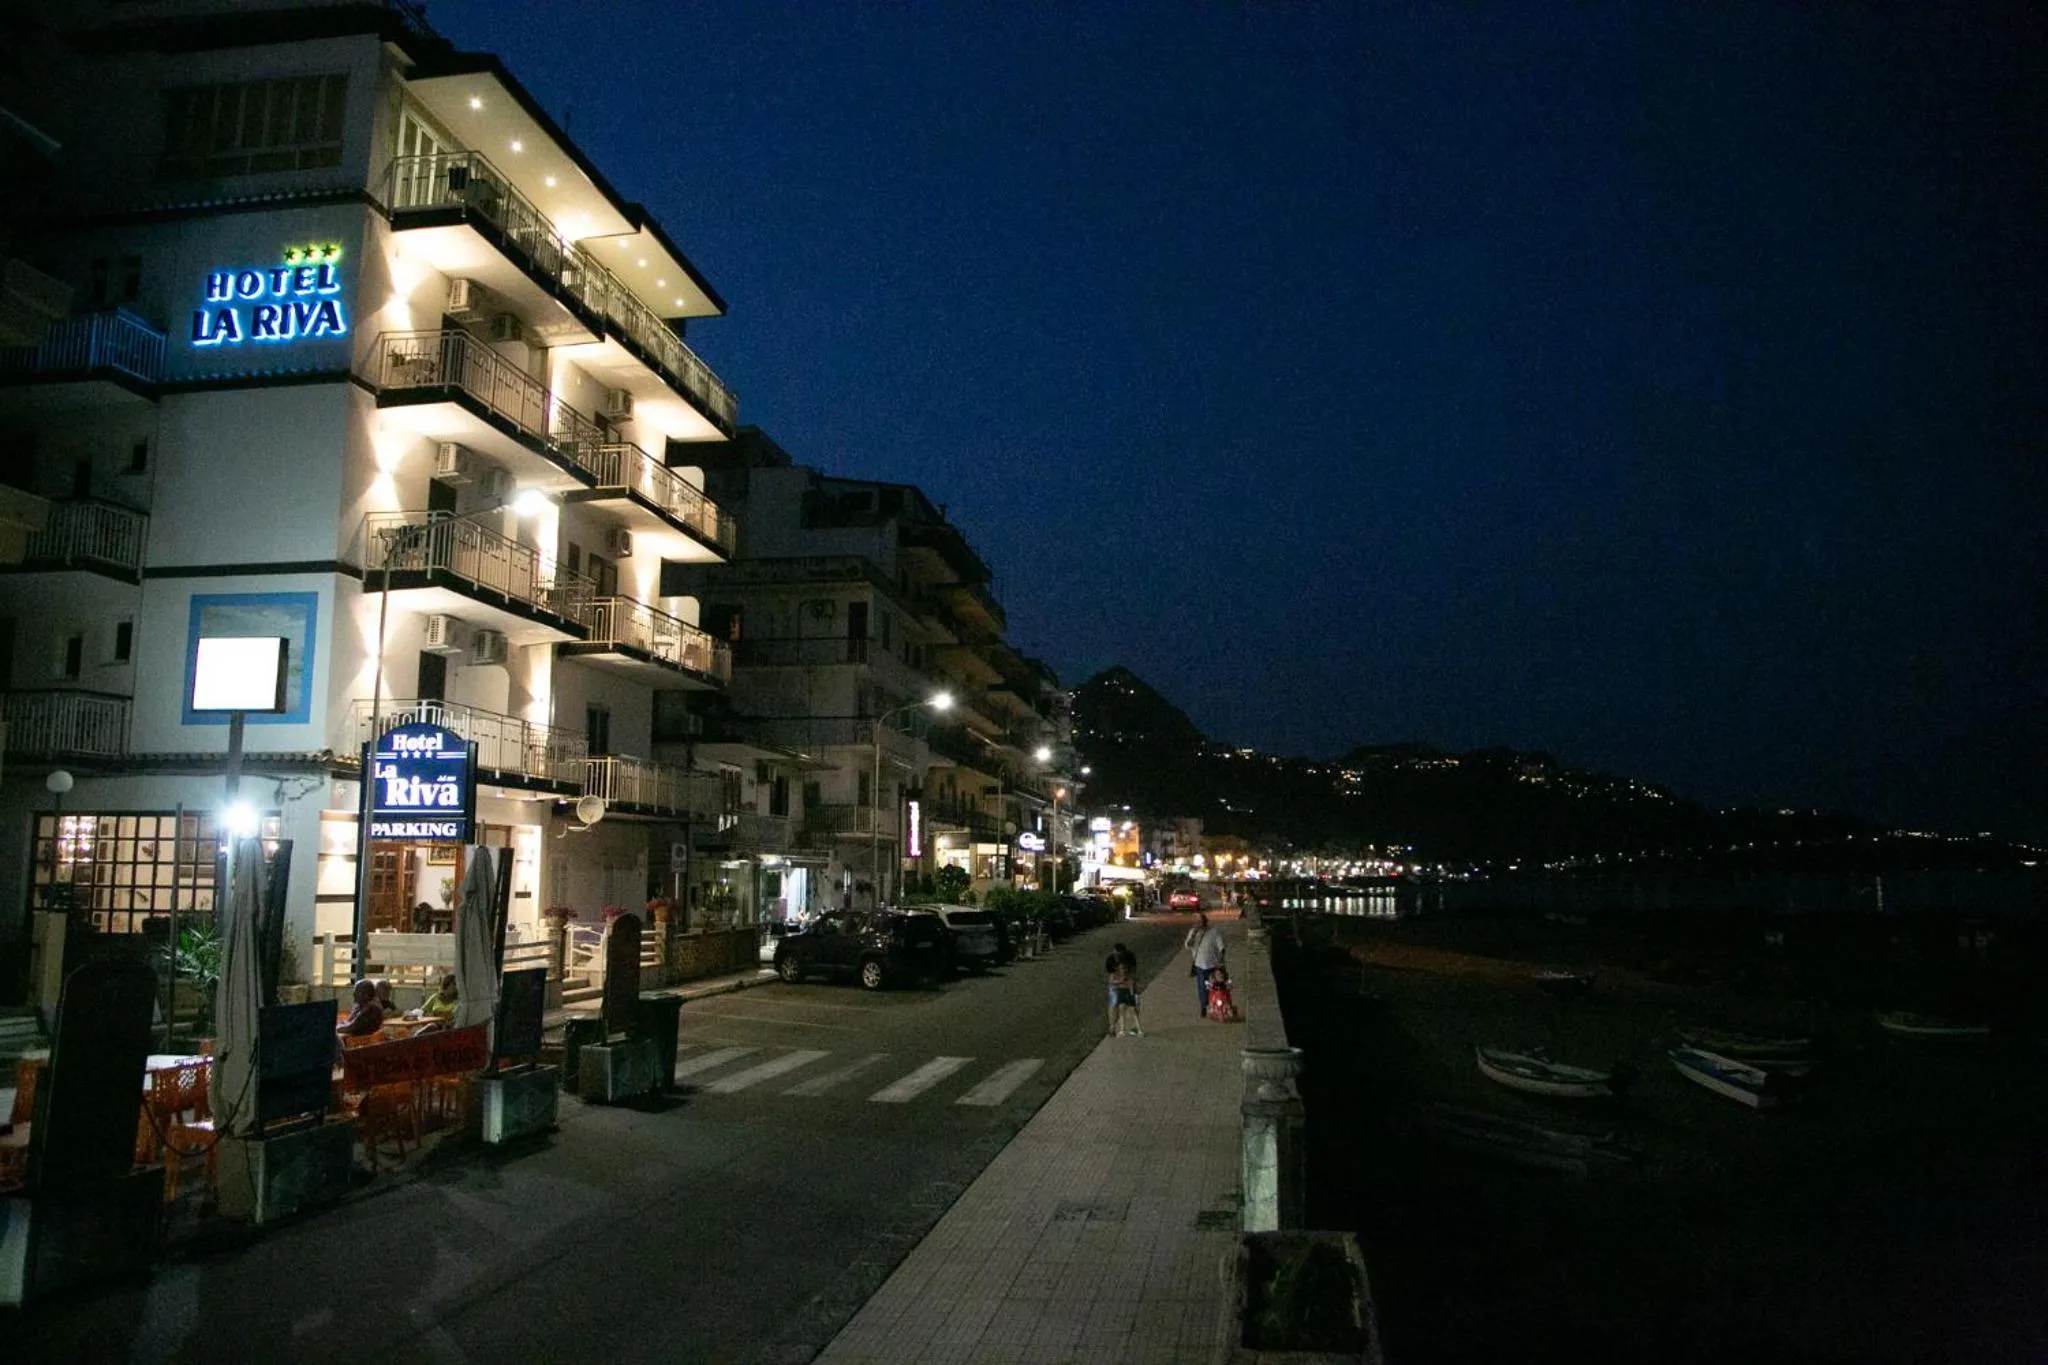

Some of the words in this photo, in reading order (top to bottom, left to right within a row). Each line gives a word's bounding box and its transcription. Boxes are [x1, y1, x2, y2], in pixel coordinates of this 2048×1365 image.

[207, 264, 340, 301] HOTEL
[191, 308, 242, 345] LA
[252, 300, 346, 339] RIVA
[392, 733, 443, 751] Hotel
[375, 762, 397, 779] La
[385, 776, 459, 806] Riva
[371, 823, 457, 836] PARKING
